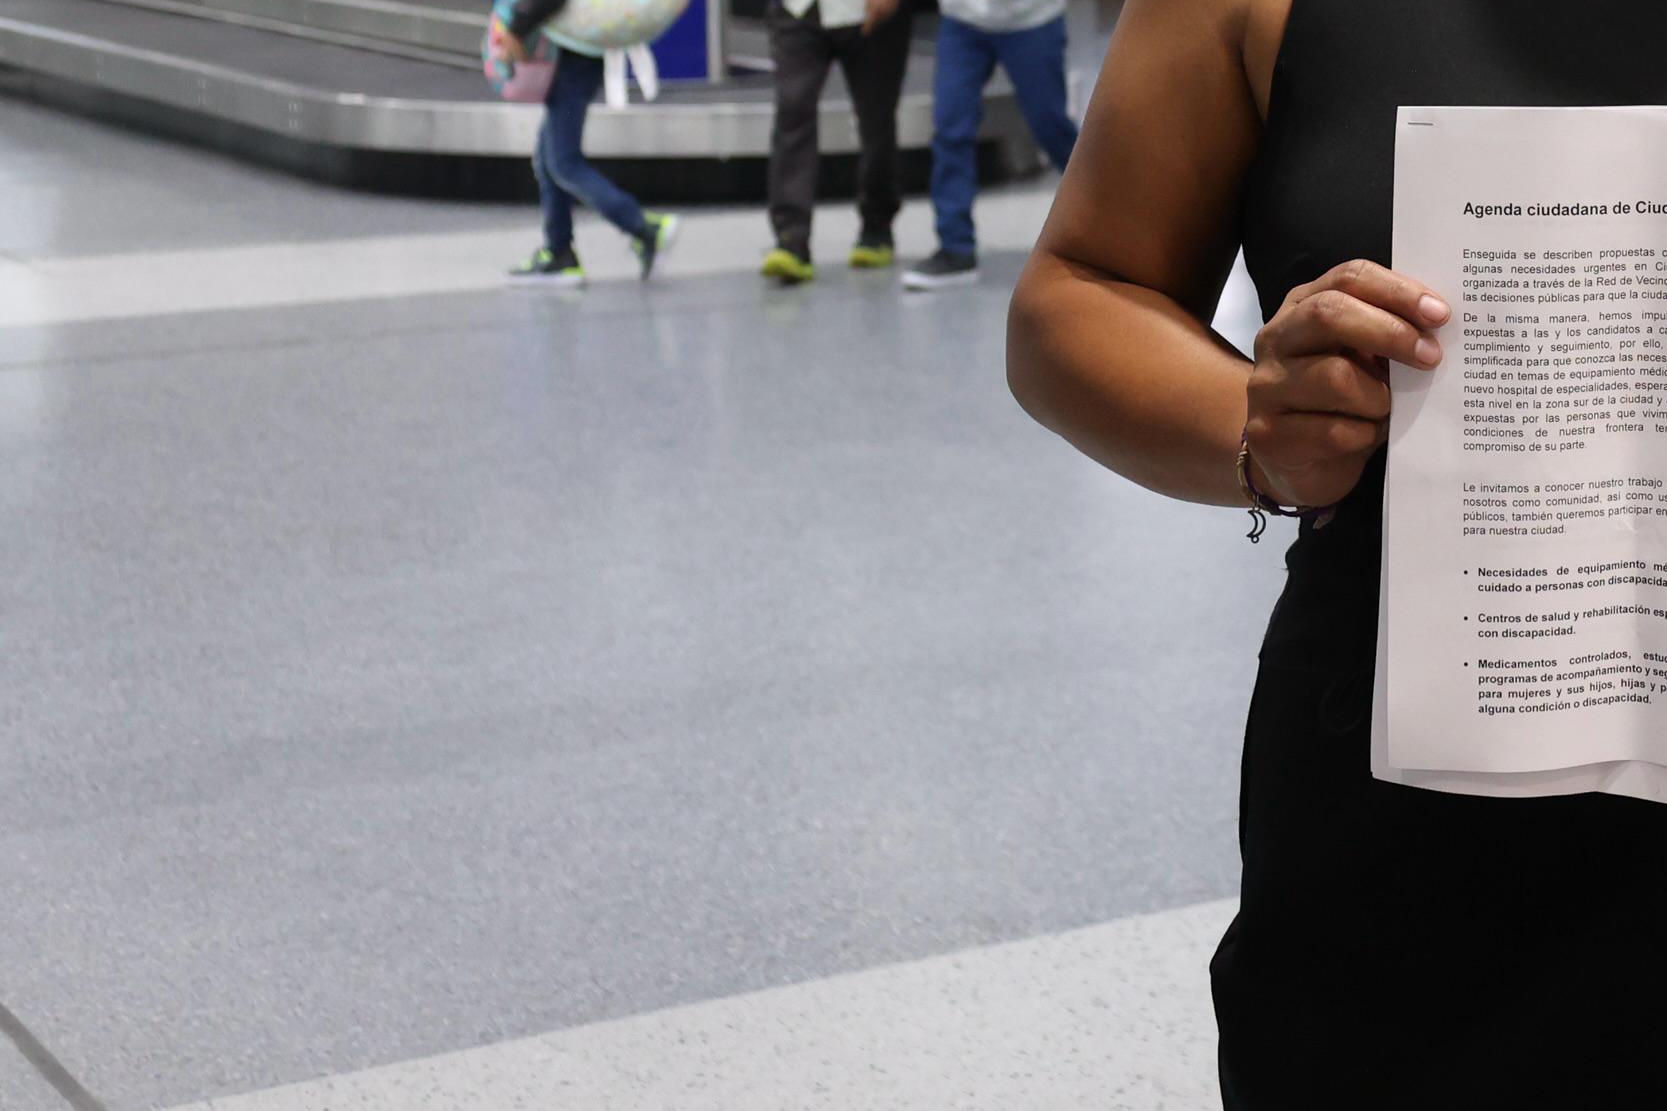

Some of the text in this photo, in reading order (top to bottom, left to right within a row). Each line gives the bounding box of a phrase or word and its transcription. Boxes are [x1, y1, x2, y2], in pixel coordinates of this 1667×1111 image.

[1463, 202, 1522, 219] Agenda
[1527, 203, 1607, 216] ciudadana
[1612, 201, 1631, 214] de
[1463, 249, 1516, 262] Enseguida
[1543, 250, 1593, 260] describen
[1599, 248, 1655, 260] propuestas
[1463, 264, 1503, 276] algunas
[1510, 264, 1576, 274] necesidades
[1584, 262, 1626, 275] urgentes
[1462, 278, 1519, 290] organizada
[1533, 278, 1565, 288] través
[1480, 292, 1535, 303] decisiones
[1538, 293, 1580, 304] públicas
[1583, 293, 1605, 304] para
[1505, 314, 1540, 324] misma
[1599, 312, 1632, 321] hemos
[1464, 328, 1515, 340] expuestas
[1586, 324, 1640, 336] candidatos
[1464, 341, 1531, 354] cumplimiento
[1550, 340, 1612, 354] seguimiento,
[1642, 338, 1663, 350] ello,
[1464, 355, 1523, 368] simplificada
[1526, 358, 1550, 369] para
[1574, 354, 1616, 365] conozca
[1464, 369, 1497, 380] ciudad
[1518, 371, 1550, 381] temas
[1569, 366, 1636, 381] equipamiento
[1464, 386, 1495, 394] nuevo
[1497, 384, 1537, 397] hospital
[1556, 381, 1631, 396] especialidades,
[1464, 398, 1485, 408] esta
[1488, 398, 1512, 409] nivel
[1546, 400, 1570, 409] zona
[1620, 394, 1654, 404] ciudad
[1464, 414, 1516, 424] expuestas
[1566, 411, 1611, 422] personas
[1464, 426, 1524, 438] condiciones
[1559, 425, 1595, 437] nuestra
[1606, 422, 1644, 432] frontera
[1463, 442, 1526, 453] compromiso
[1480, 483, 1529, 493] invitamos
[1544, 482, 1584, 492] conocer
[1588, 478, 1624, 490] nuestro
[1628, 477, 1663, 490] trabajo
[1463, 498, 1507, 507] nosotros
[1512, 499, 1541, 508] como
[1625, 492, 1654, 501] como
[1463, 508, 1508, 522] públicos,
[1512, 509, 1553, 522] también
[1555, 509, 1605, 522] queremos
[1608, 504, 1653, 518] participar
[1463, 527, 1486, 536] para
[1489, 526, 1528, 535] nuestra
[1478, 568, 1548, 578] Necesidades
[1577, 560, 1646, 577] equipamiento
[1478, 582, 1522, 592] cuidado
[1535, 581, 1584, 594] personas
[1586, 576, 1606, 588] con
[1478, 613, 1522, 623] Centros
[1542, 611, 1570, 622] salud
[1582, 604, 1650, 618] rehabilitación
[1478, 625, 1576, 640] con discapacidad.
[1478, 659, 1558, 669] Medicamentos
[1569, 650, 1631, 666] controlados,
[1478, 675, 1538, 686] programas
[1556, 664, 1642, 681] acompañamiento
[1478, 691, 1502, 701] para
[1508, 688, 1551, 701] mujeres
[1567, 685, 1585, 695] sus
[1620, 678, 1646, 690] hijas
[1478, 692, 1652, 716] alguna condición discapacidad.
